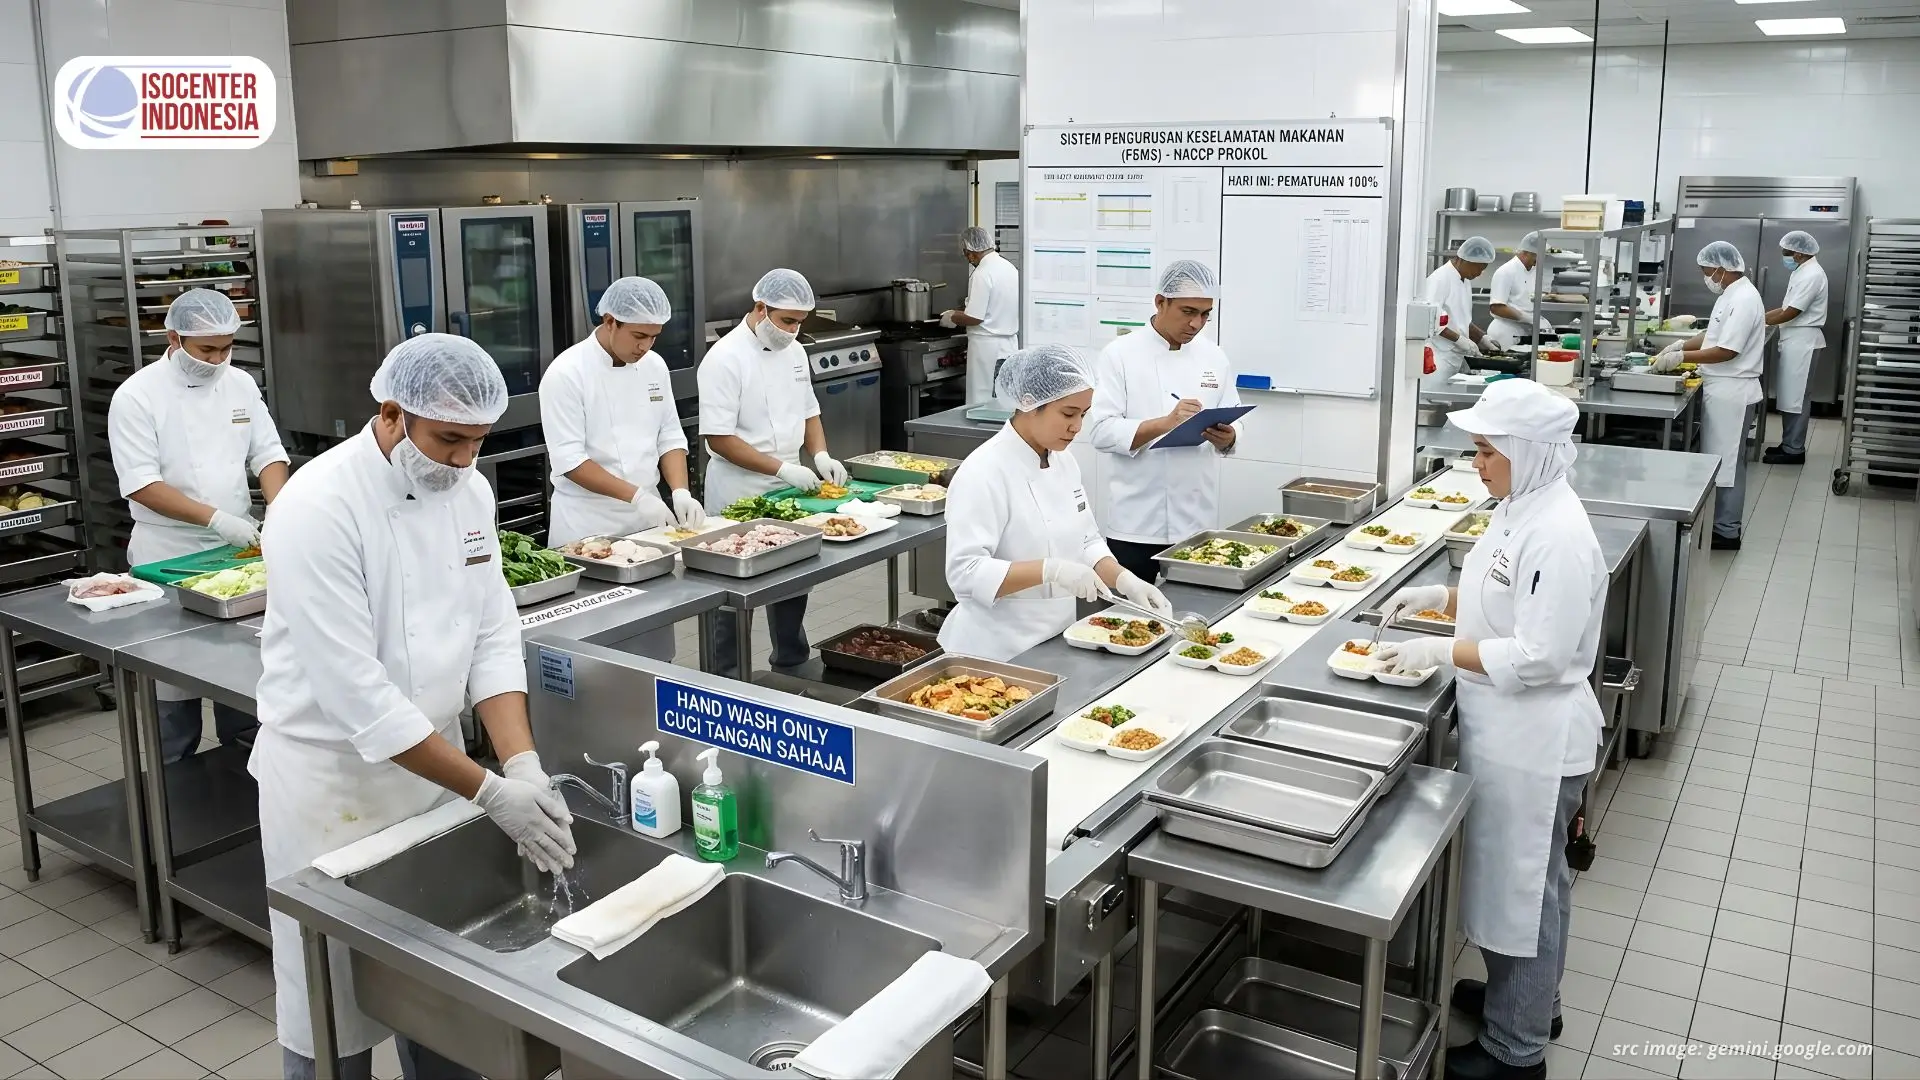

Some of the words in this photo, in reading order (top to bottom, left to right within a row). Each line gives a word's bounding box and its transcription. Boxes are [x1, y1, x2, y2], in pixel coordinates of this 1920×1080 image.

[1060, 132, 1101, 145] SISTEM
[1104, 131, 1183, 144] PENGURUSAN
[1187, 129, 1275, 143] KESELAMATAN
[1279, 129, 1344, 142] MAKANAN
[1174, 148, 1214, 160] NACCP
[1218, 148, 1268, 160] PROKOL
[1228, 175, 1253, 186] HARI
[1256, 175, 1274, 187] INI:
[1277, 175, 1344, 187] PEMATUHAN
[1348, 176, 1379, 188] 100%
[677, 690, 723, 718] HAND
[727, 703, 777, 733] WASH
[782, 718, 829, 746] ONLY
[664, 709, 701, 735] CUCI
[705, 720, 772, 755] TANGAN
[776, 740, 847, 775] SAHAJA
